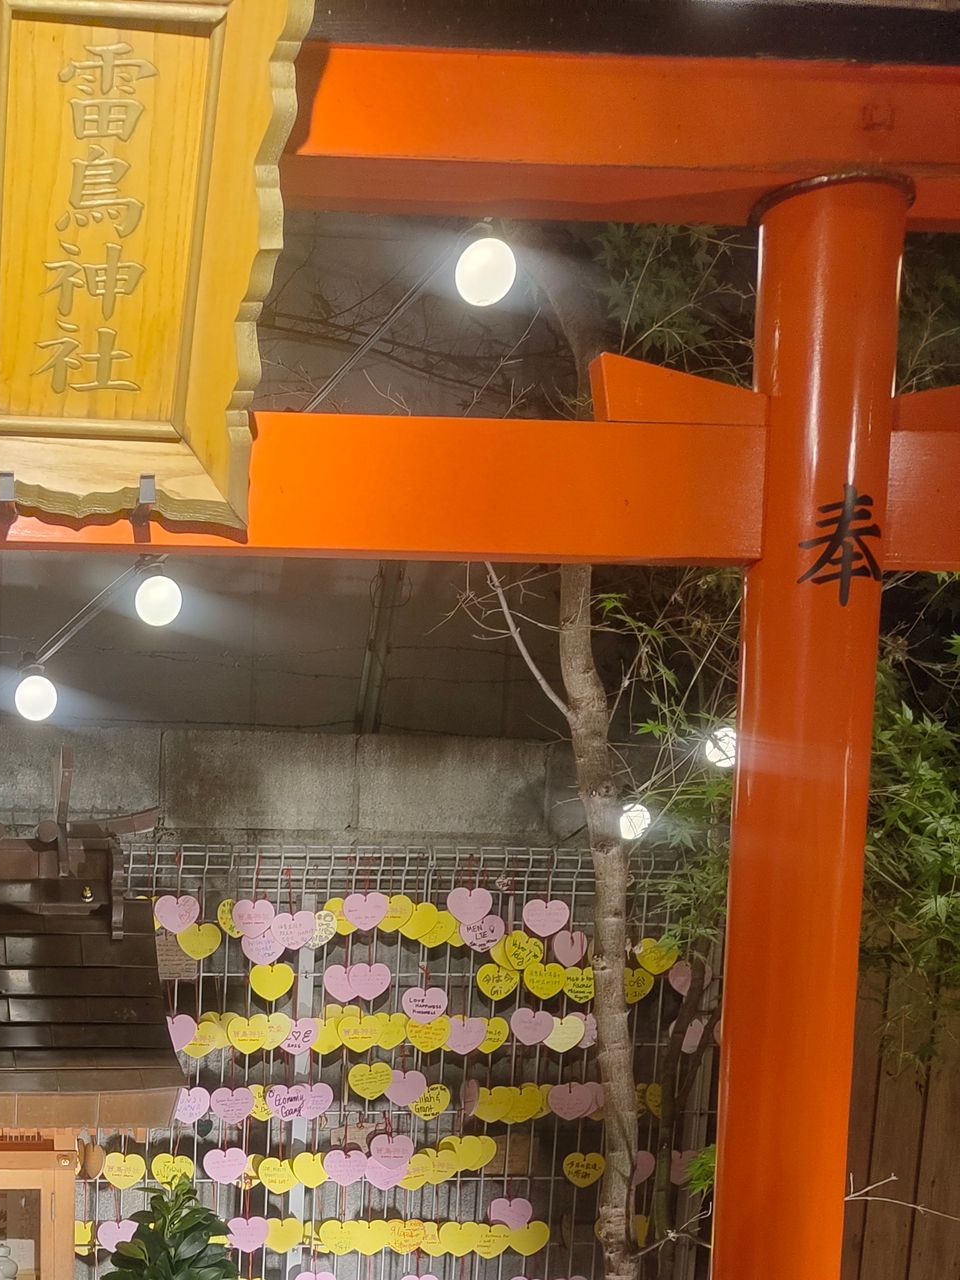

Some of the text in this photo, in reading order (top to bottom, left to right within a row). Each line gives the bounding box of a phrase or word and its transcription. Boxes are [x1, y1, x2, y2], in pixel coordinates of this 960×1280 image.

[31, 41, 159, 394] 雷鳥神社
[796, 484, 882, 607] 奉
